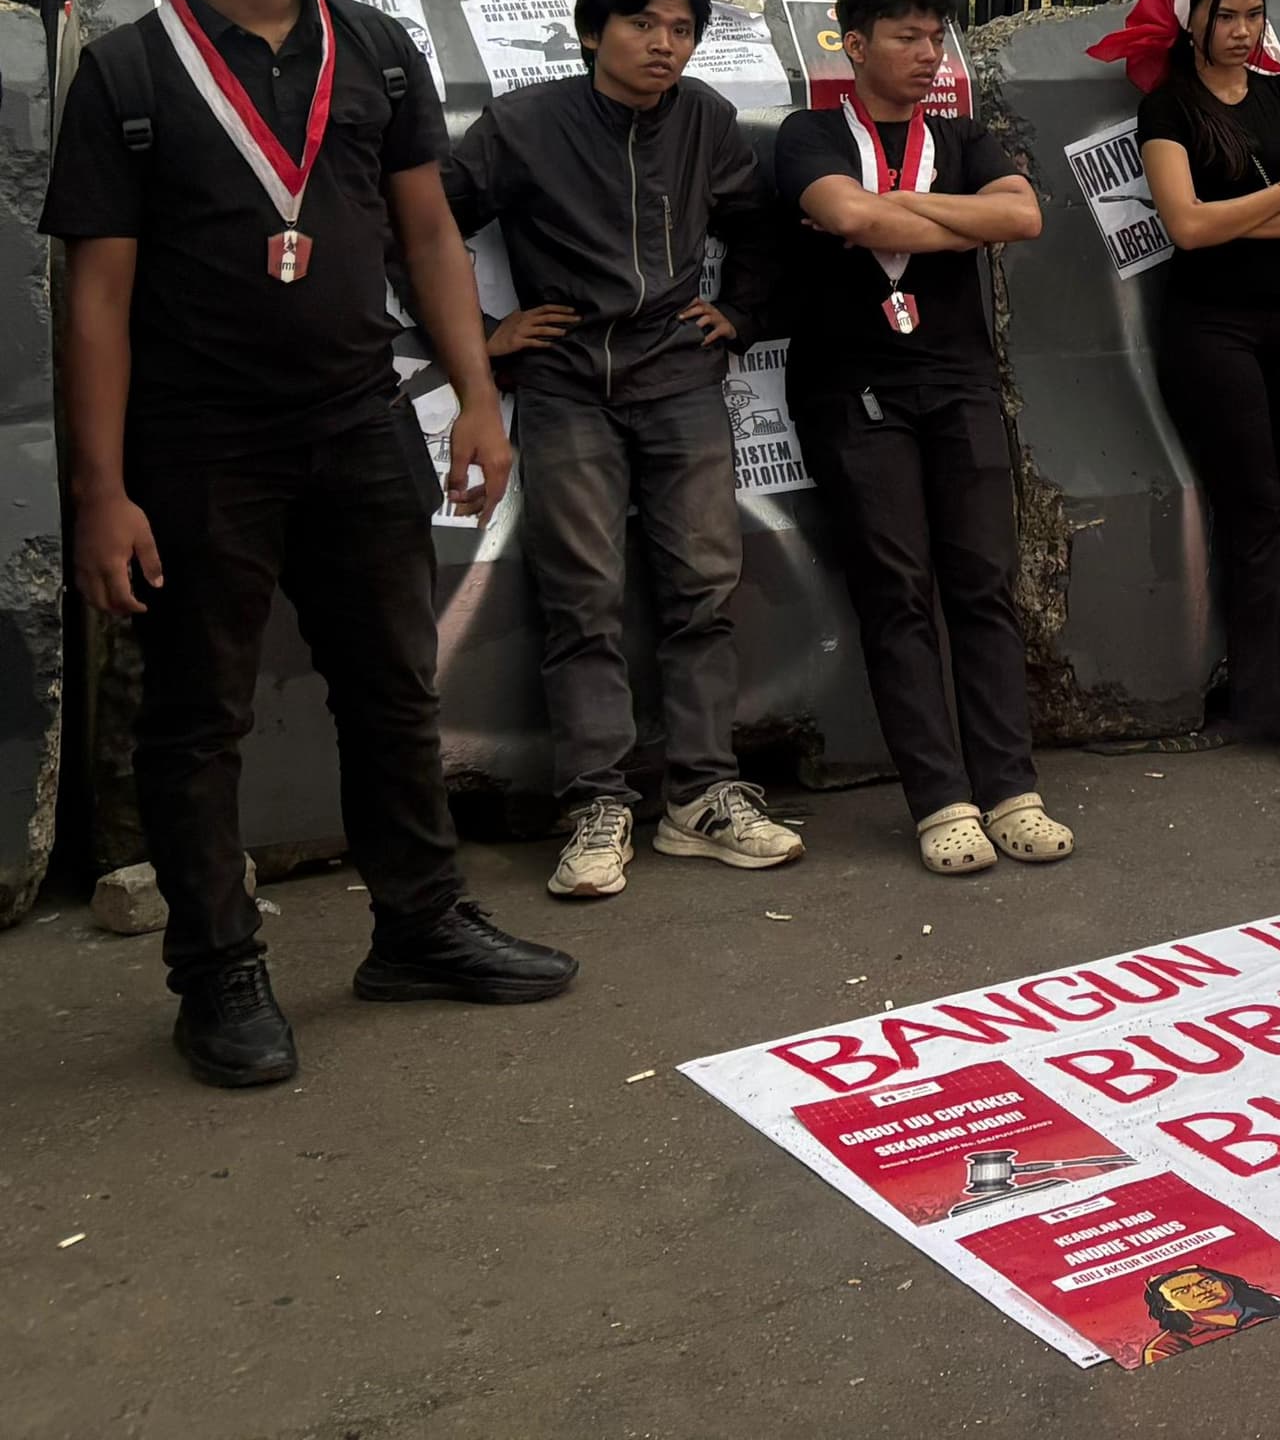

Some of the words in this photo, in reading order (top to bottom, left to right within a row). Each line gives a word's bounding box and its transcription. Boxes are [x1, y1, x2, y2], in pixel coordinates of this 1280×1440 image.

[1073, 132, 1144, 198] MAYD
[1108, 214, 1168, 265] LIBERA
[767, 944, 1242, 1091] BANGUN
[839, 1121, 904, 1146] CABUT
[903, 1114, 935, 1129] UU
[933, 1091, 1024, 1122] CIPTAKER
[874, 1126, 968, 1157] SEKARANG
[1054, 1221, 1123, 1248] KEADILAN
[1119, 1210, 1157, 1230] BAGI
[1063, 1239, 1131, 1267] ANDRIE
[1124, 1220, 1187, 1248] YUNUS
[1104, 1259, 1146, 1277] AKTOR
